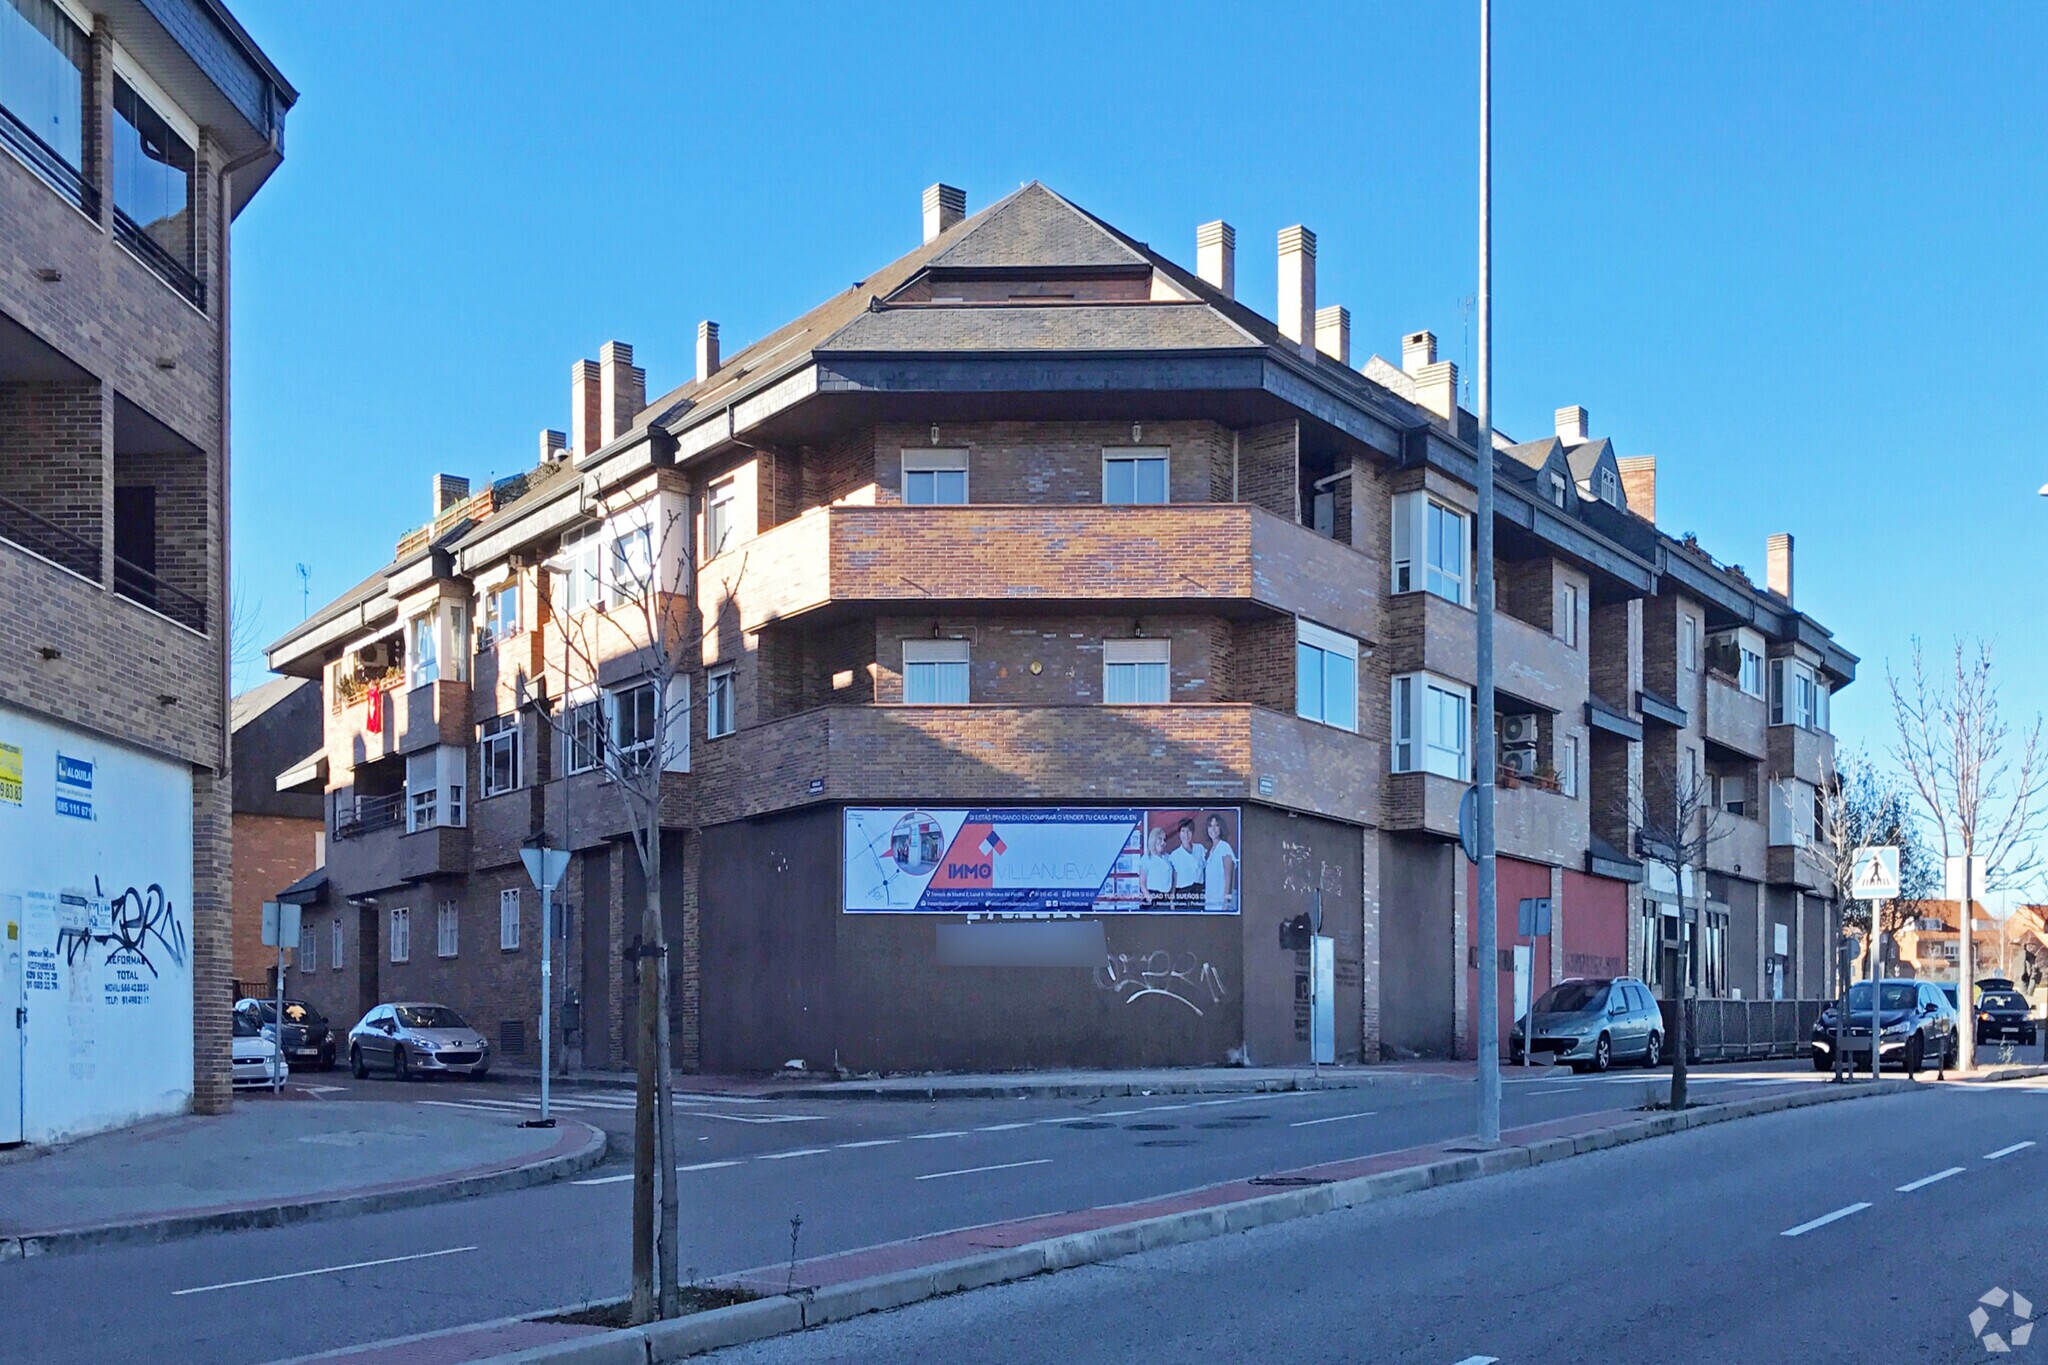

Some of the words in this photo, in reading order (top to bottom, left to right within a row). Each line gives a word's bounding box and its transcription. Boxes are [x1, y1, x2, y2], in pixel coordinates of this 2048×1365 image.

[67, 767, 91, 781] ALQUILA
[69, 803, 80, 815] 111
[948, 863, 992, 880] INMO
[995, 862, 1098, 880] VILLANUEVA
[1164, 892, 1175, 900] TUS
[1176, 891, 1200, 900] SUEÑOS
[116, 970, 139, 980] TOTAL
